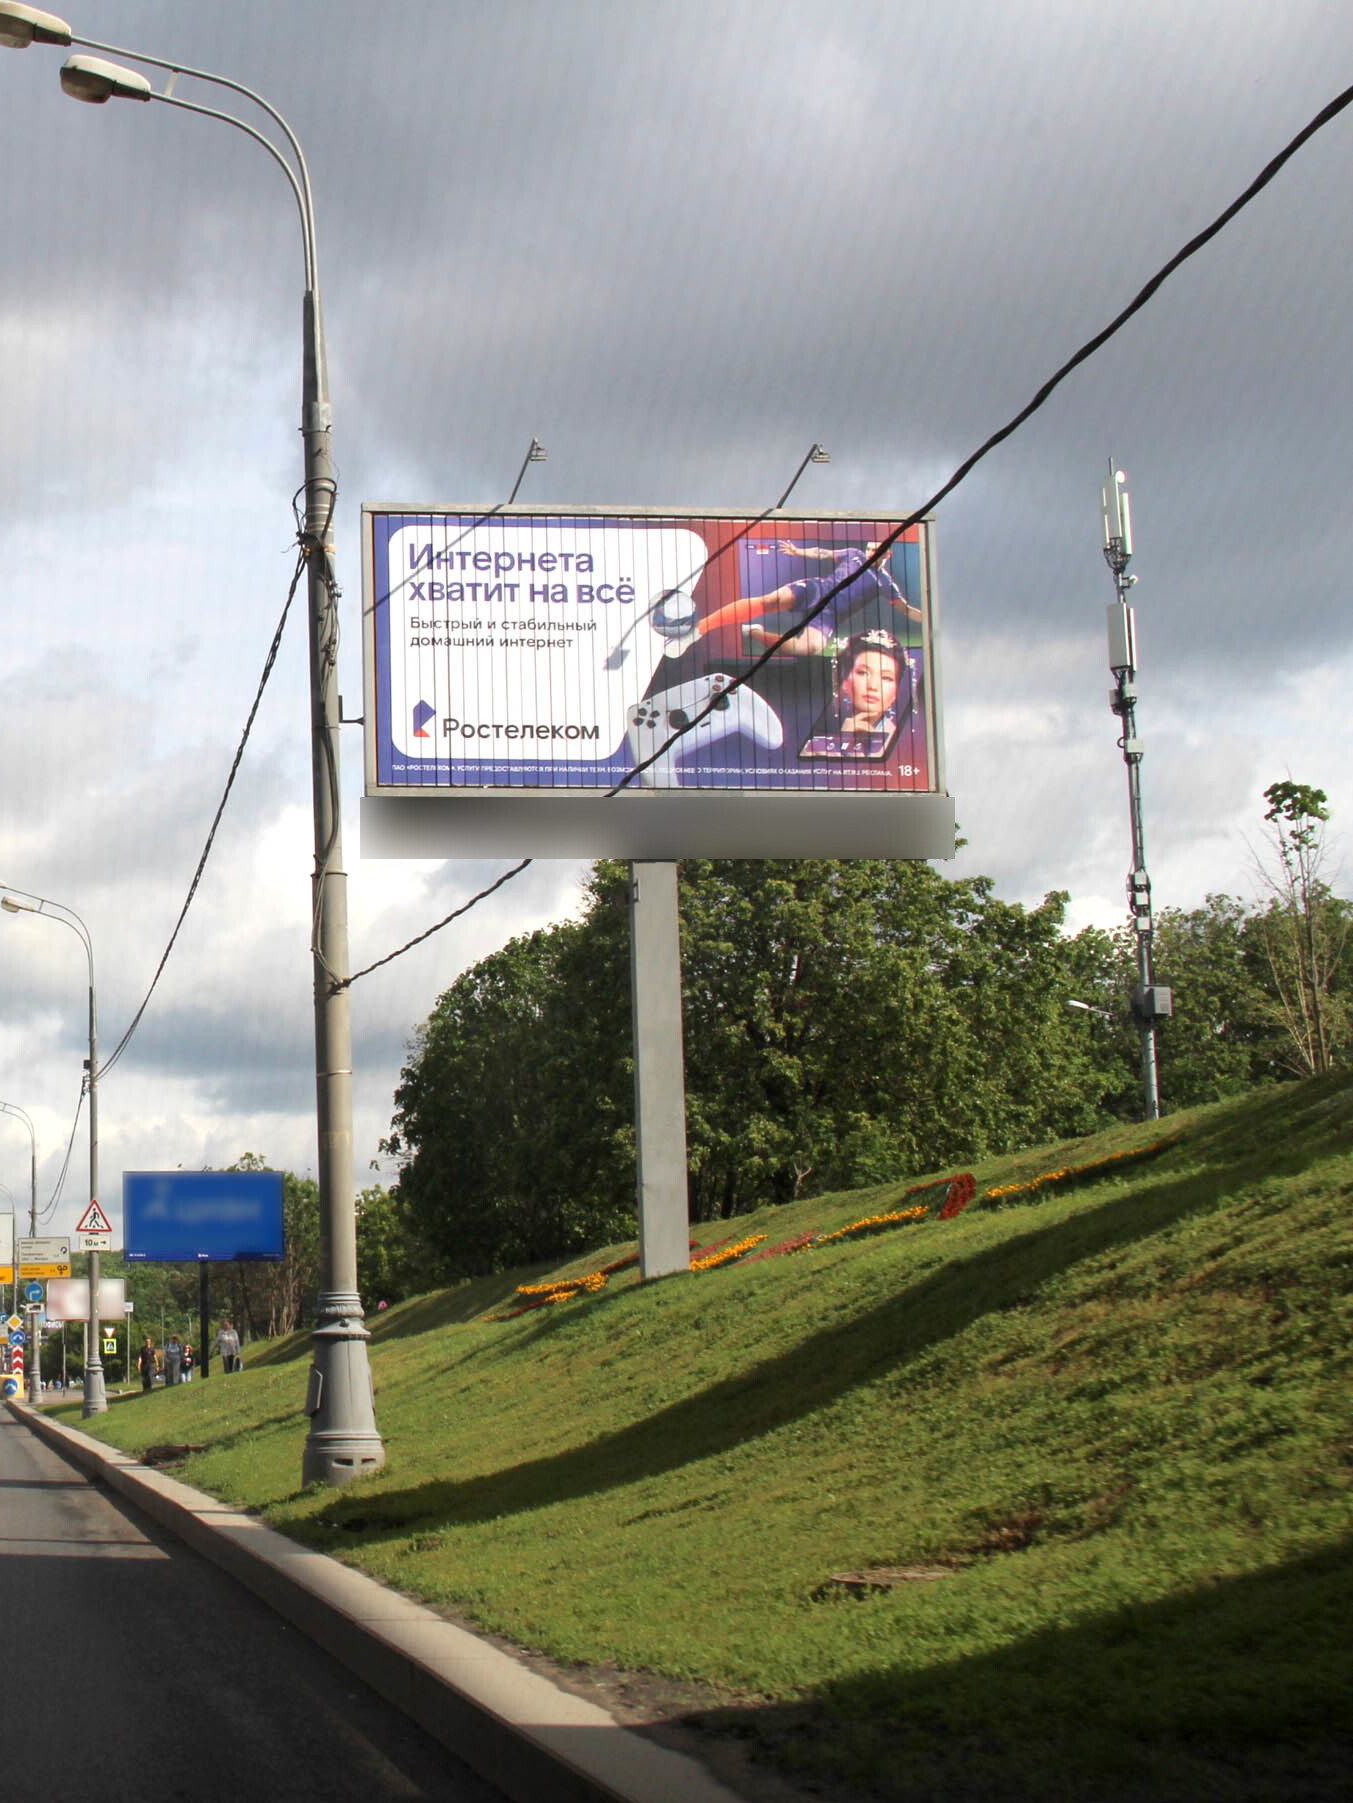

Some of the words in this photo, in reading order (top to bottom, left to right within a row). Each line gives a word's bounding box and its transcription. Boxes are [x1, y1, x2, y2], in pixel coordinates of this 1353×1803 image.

[408, 543, 595, 578] Интернета
[408, 580, 520, 602] хватит
[529, 582, 569, 603] на
[577, 577, 635, 604] всё
[410, 616, 483, 632] Быстрый
[487, 620, 496, 630] и
[501, 618, 597, 631] стабильный
[410, 636, 495, 648] домашний
[500, 637, 574, 650] интернет
[443, 718, 600, 740] Ростелеком
[898, 764, 921, 776] 18+
[84, 1239, 93, 1247] 10
